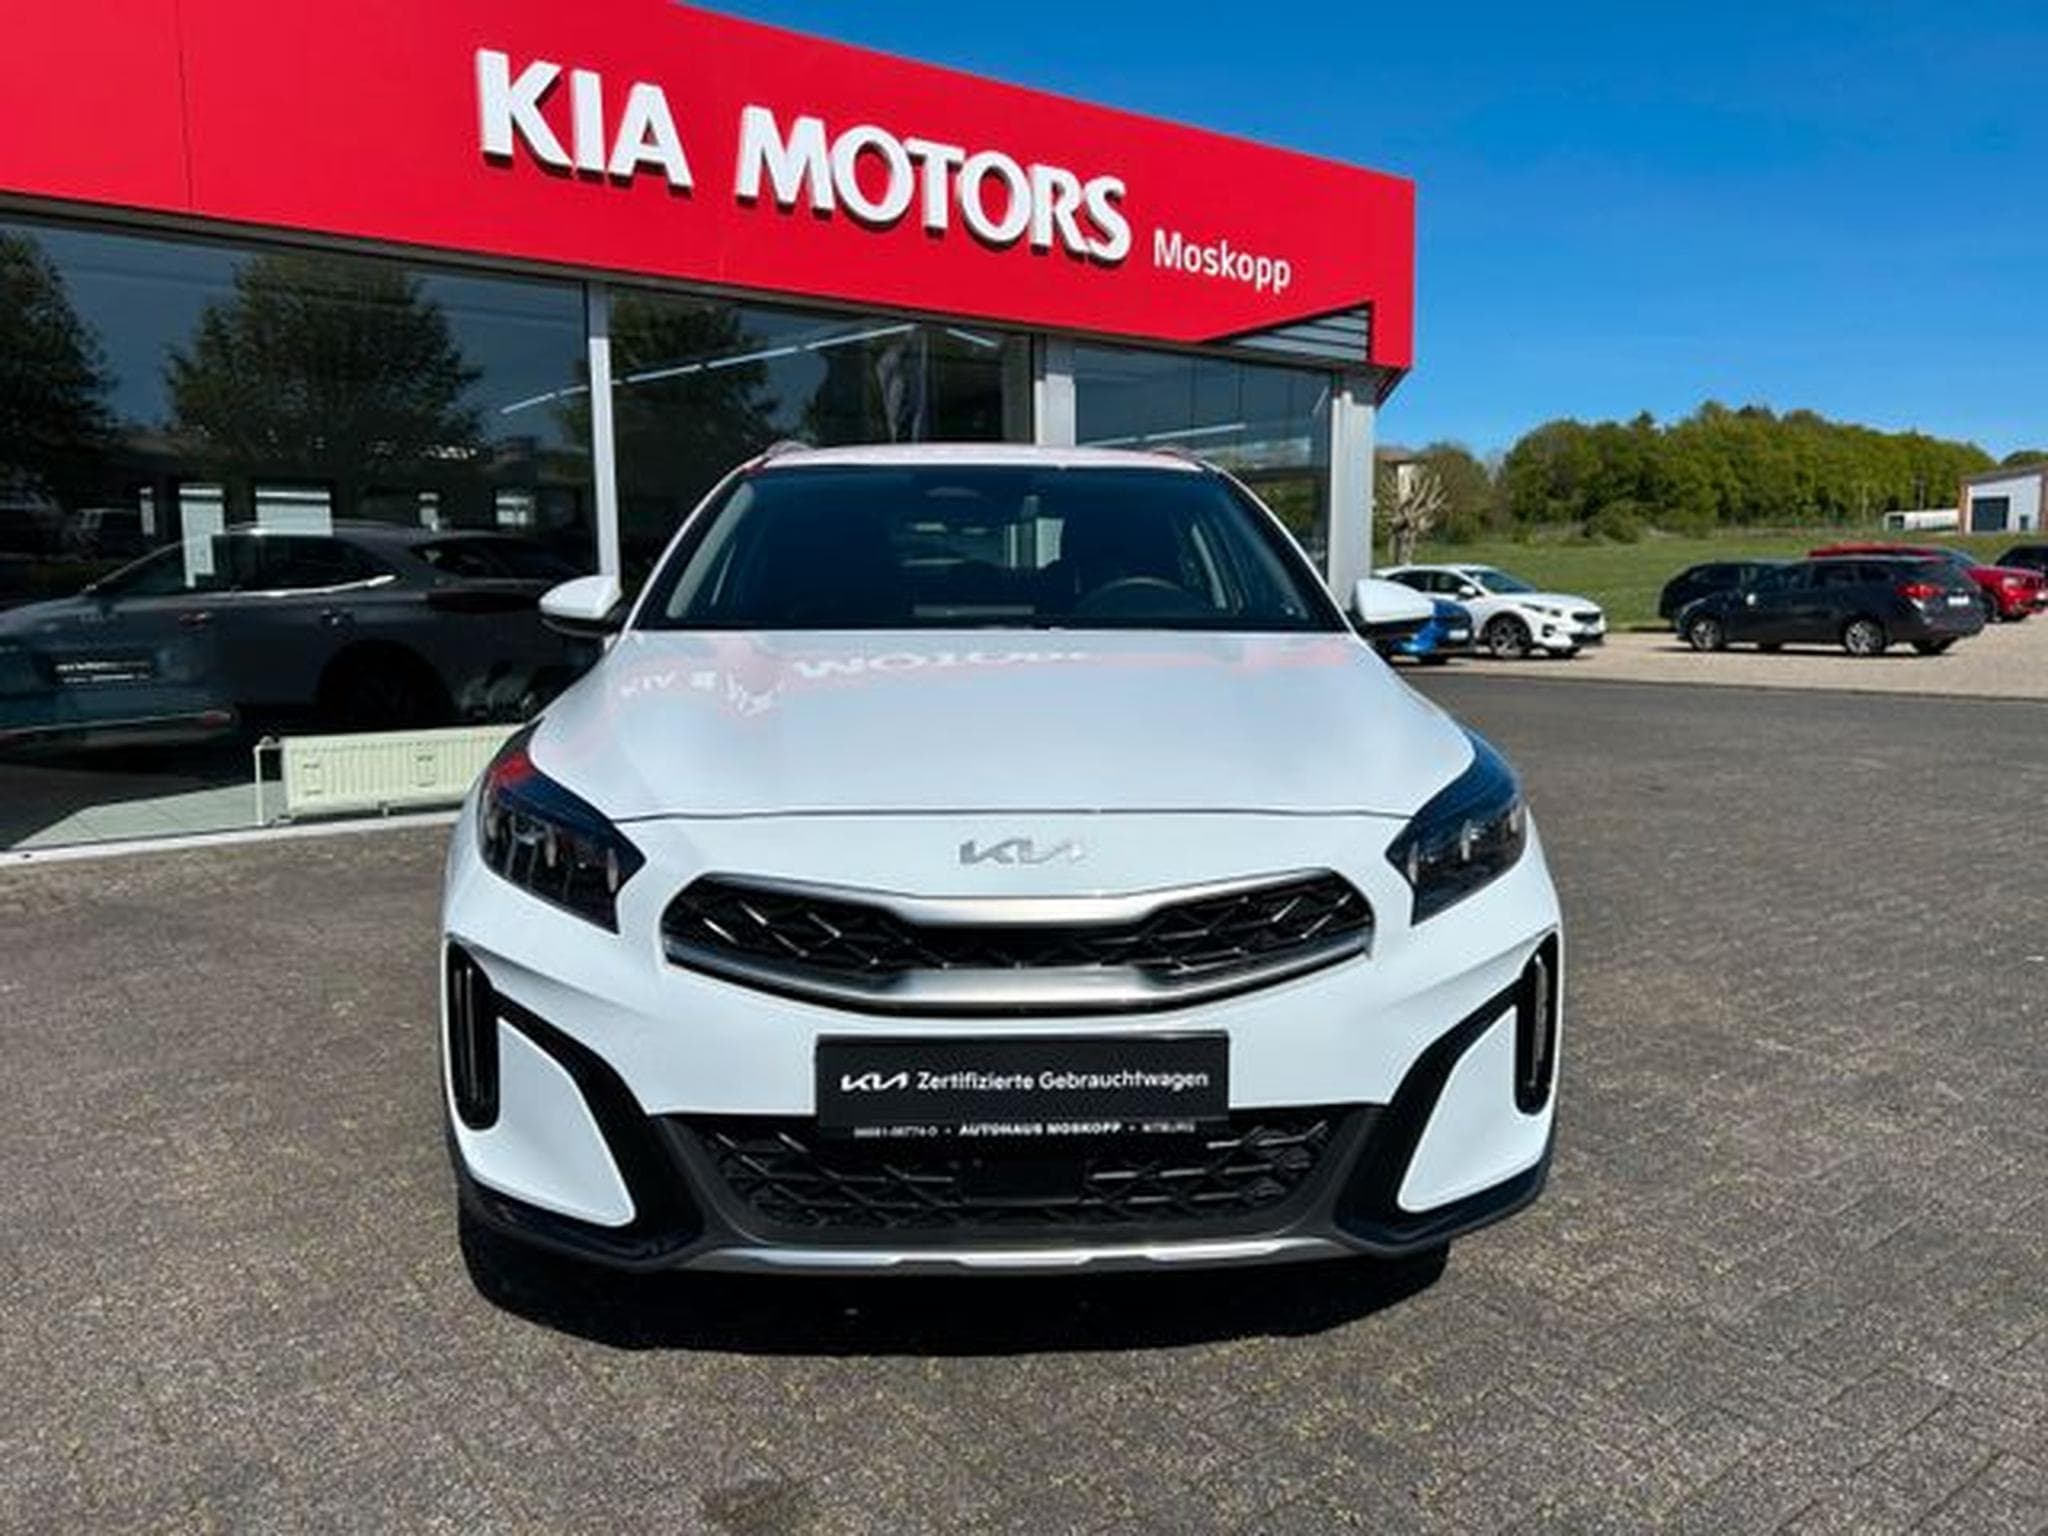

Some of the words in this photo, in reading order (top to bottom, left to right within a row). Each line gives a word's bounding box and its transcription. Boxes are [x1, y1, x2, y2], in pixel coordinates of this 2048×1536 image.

[475, 48, 693, 190] KIA
[735, 105, 1132, 263] MOTORS
[1153, 229, 1292, 294] Moskopp
[840, 1071, 909, 1092] KIA
[917, 1070, 1035, 1091] Zertifizierte
[1038, 1070, 1209, 1092] Gebrauchtwagen
